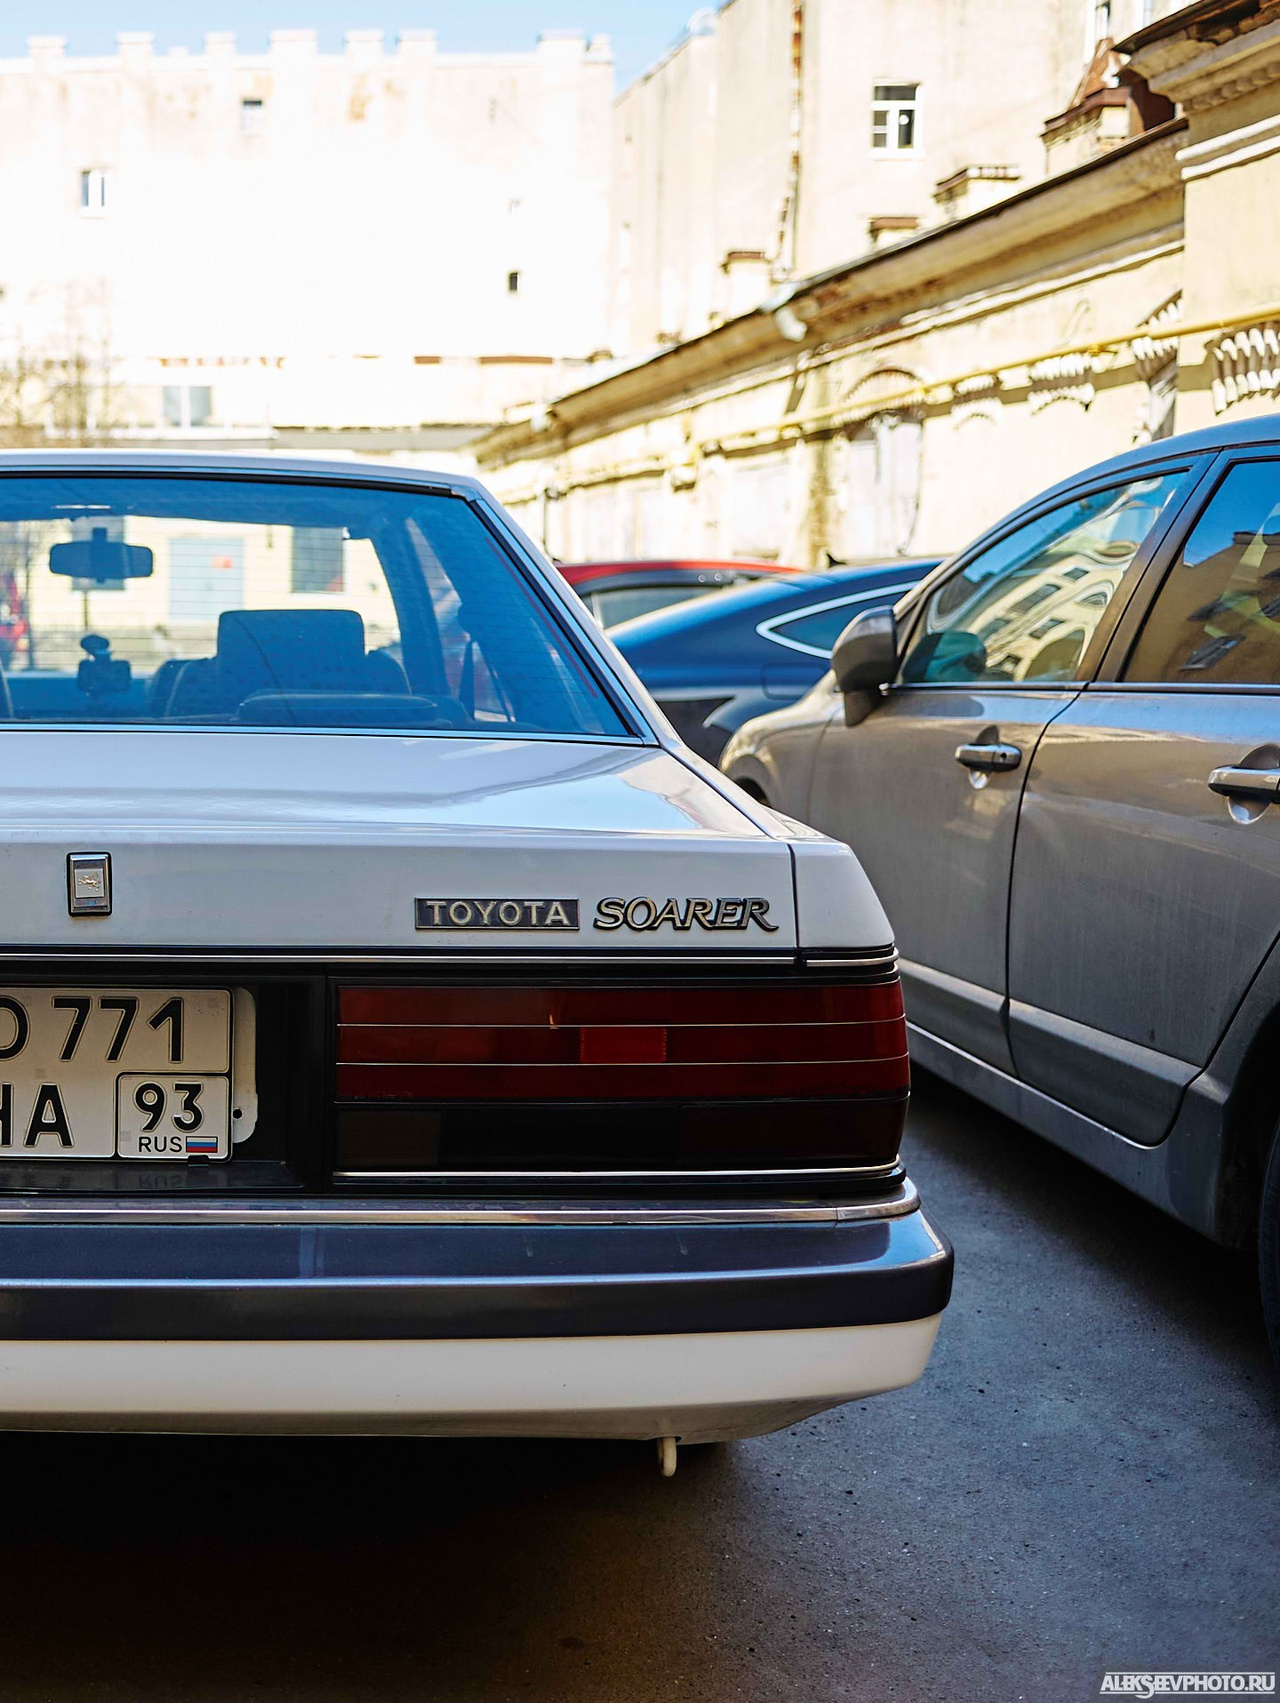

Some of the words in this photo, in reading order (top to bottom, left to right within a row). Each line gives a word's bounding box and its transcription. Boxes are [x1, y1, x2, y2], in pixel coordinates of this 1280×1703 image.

[425, 900, 570, 926] TOYOTA
[593, 896, 780, 931] SOARER
[53, 997, 183, 1063] 771
[133, 1083, 204, 1132] 93
[138, 1136, 183, 1153] RUS
